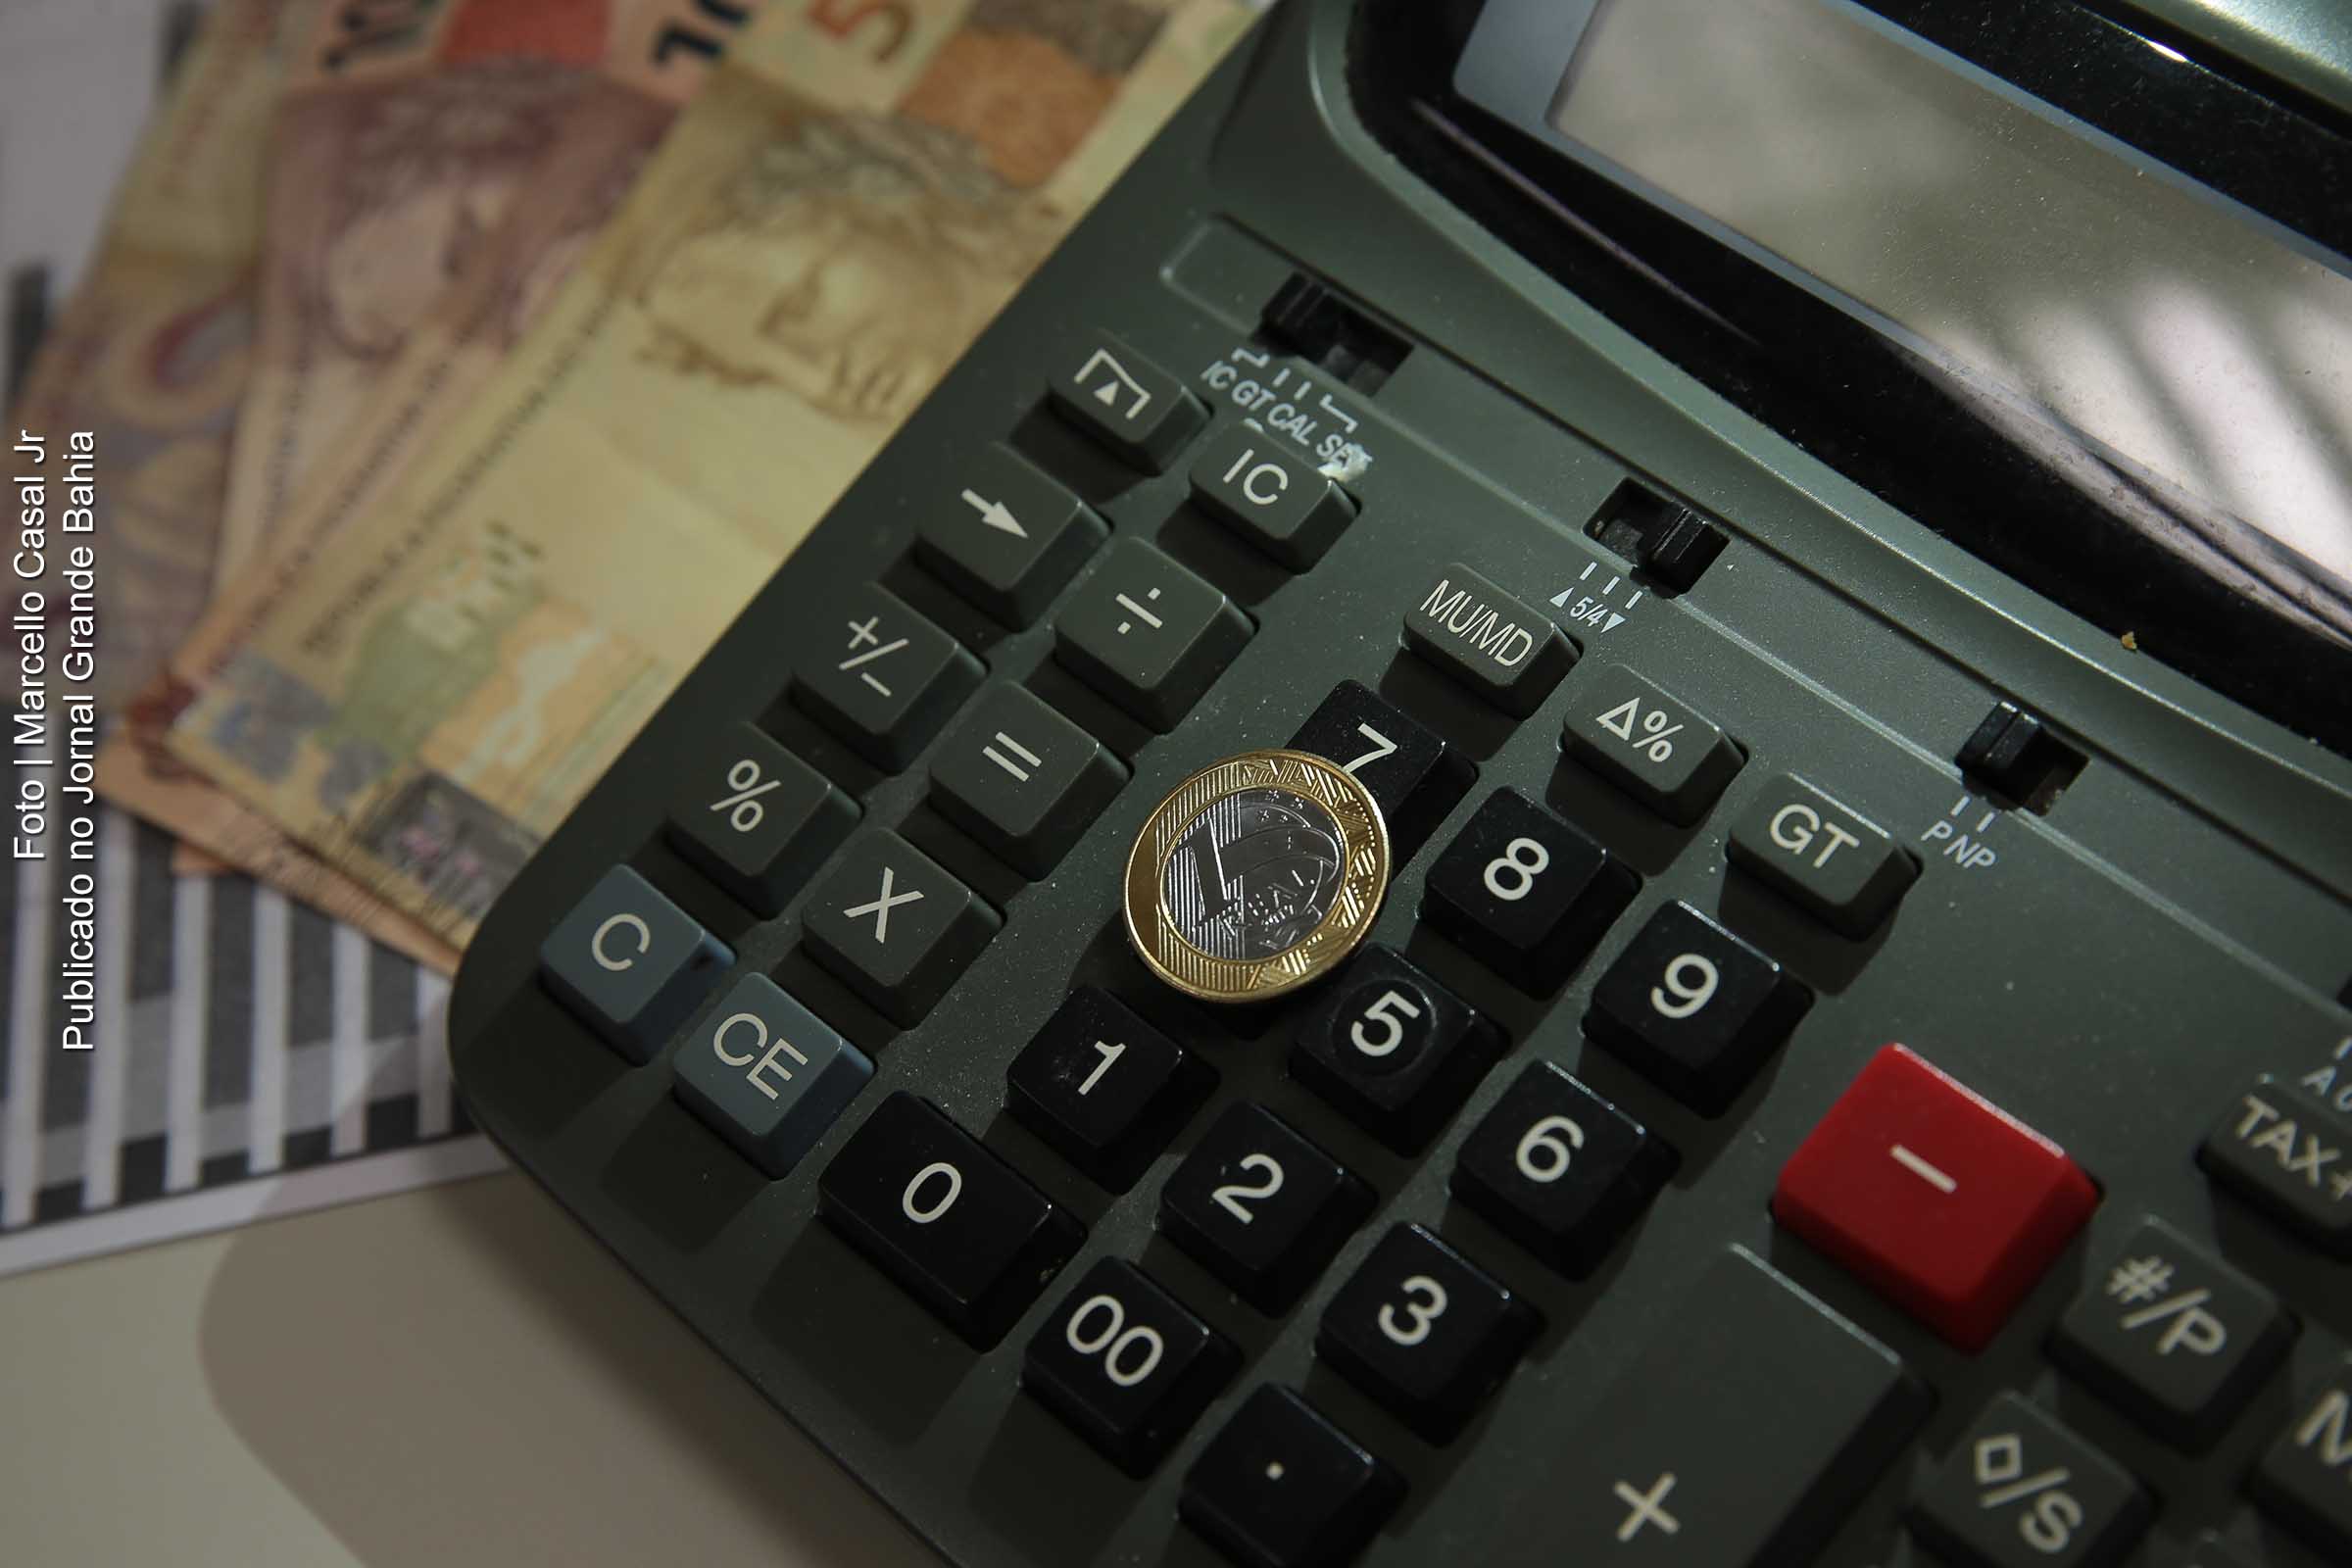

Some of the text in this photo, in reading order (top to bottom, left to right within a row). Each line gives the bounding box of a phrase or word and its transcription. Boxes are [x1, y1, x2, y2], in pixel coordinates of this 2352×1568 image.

[1200, 360, 1238, 389] IC
[1231, 379, 1276, 411] GT
[1267, 403, 1318, 446] CAL
[1222, 449, 1289, 505] IC
[1419, 579, 1533, 666] MU/MD
[1343, 722, 1398, 774] 7
[710, 760, 781, 832] %
[1483, 837, 1549, 901] 8
[1770, 804, 1860, 868] GT
[1921, 821, 1996, 870] P NP
[591, 913, 651, 971] C
[1651, 954, 1719, 1018] 9
[1350, 990, 1420, 1056] 5
[713, 1012, 808, 1101] CE
[1077, 1040, 1126, 1096] 1
[1516, 1115, 1585, 1183] 6
[902, 1161, 962, 1224] 0
[1211, 1153, 1284, 1224] 2
[1378, 1276, 1447, 1346] 3
[2107, 1255, 2227, 1355] #/P
[1066, 1295, 1163, 1386] 00
